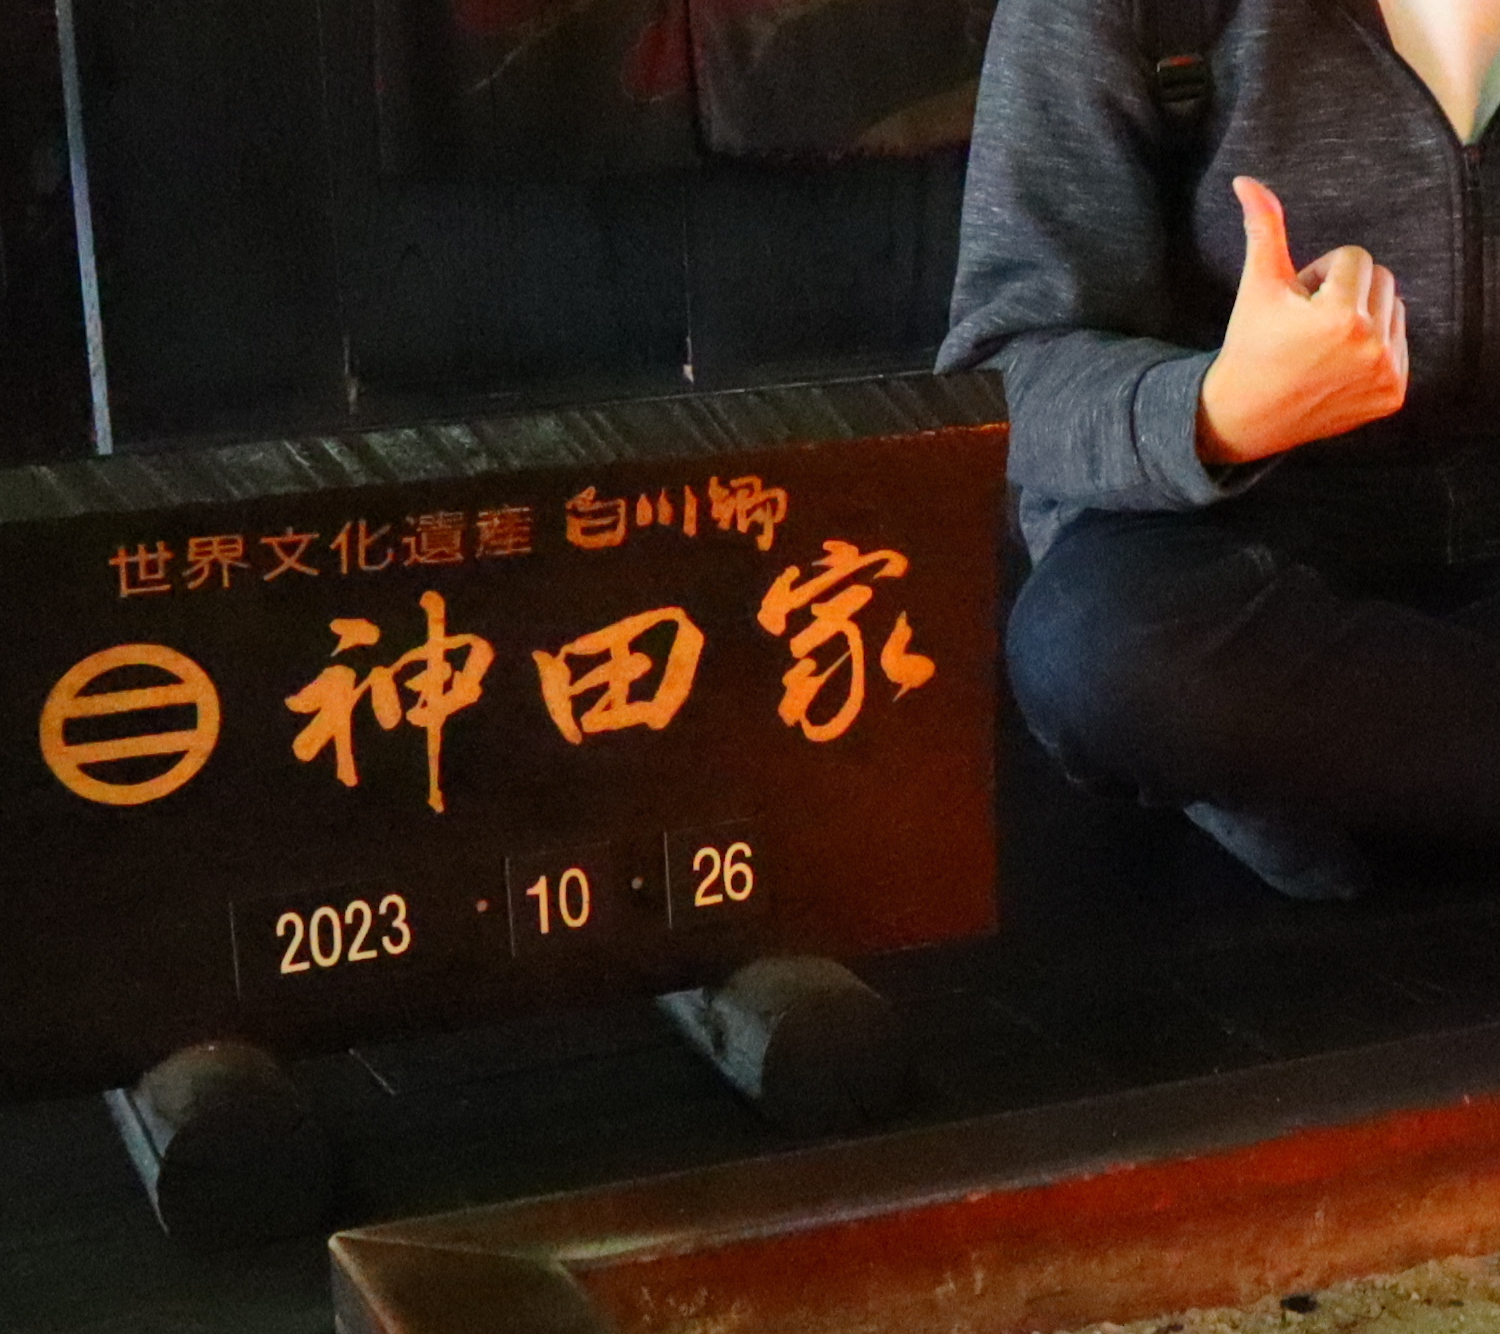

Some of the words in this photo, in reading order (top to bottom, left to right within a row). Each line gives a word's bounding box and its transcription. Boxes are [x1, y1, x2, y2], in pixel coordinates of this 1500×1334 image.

[109, 506, 533, 598] 世界文化遺産
[565, 475, 789, 551] 白川郷
[285, 540, 935, 812] 神田家
[275, 893, 412, 974] 2023
[526, 867, 591, 934] 10
[692, 841, 754, 907] 26
